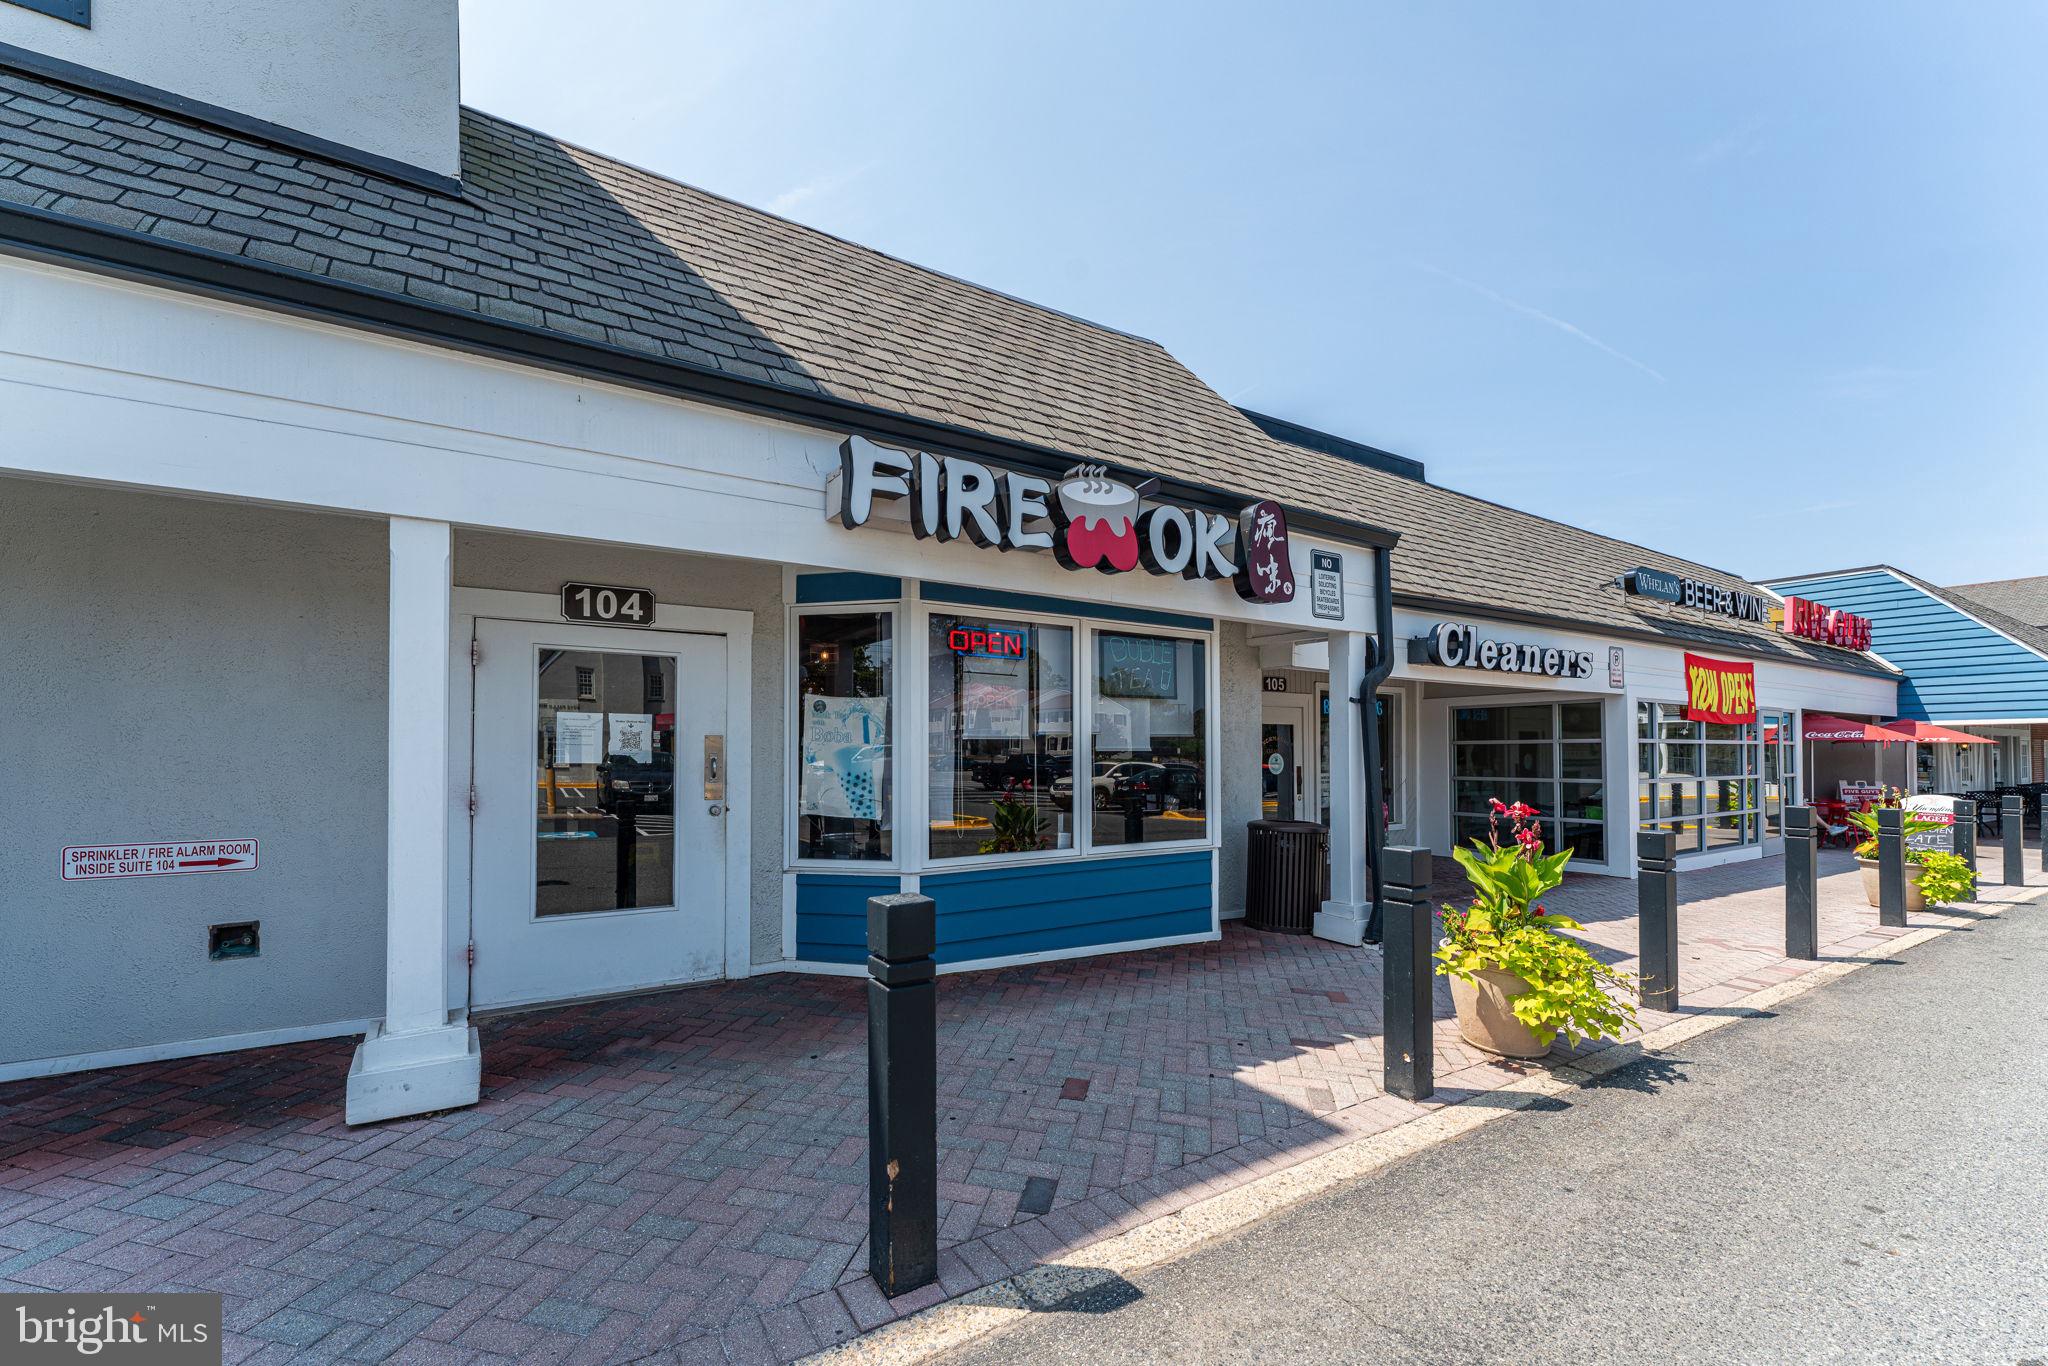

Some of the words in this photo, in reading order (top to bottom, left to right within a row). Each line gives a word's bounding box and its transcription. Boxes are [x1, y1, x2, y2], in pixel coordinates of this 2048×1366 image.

[842, 434, 1054, 550] FIRE
[1321, 558, 1332, 568] NO
[575, 588, 644, 621] 104
[1685, 578, 1722, 613] BEER
[1726, 591, 1734, 614] &
[1736, 591, 1769, 622] WINE
[948, 629, 1022, 656] OPEN
[1434, 622, 1594, 679] Cleaners
[1264, 678, 1286, 691] 105
[1914, 815, 1949, 823] LAGER
[1905, 834, 1948, 845] LATE
[71, 849, 139, 862] SPRINKLER
[142, 848, 146, 859] /
[148, 847, 174, 858] FIRE
[176, 845, 216, 857] ALARM
[218, 844, 251, 855] ROOM
[75, 862, 115, 875] INSIDE
[119, 861, 153, 872] SUITE
[156, 860, 175, 871] 104
